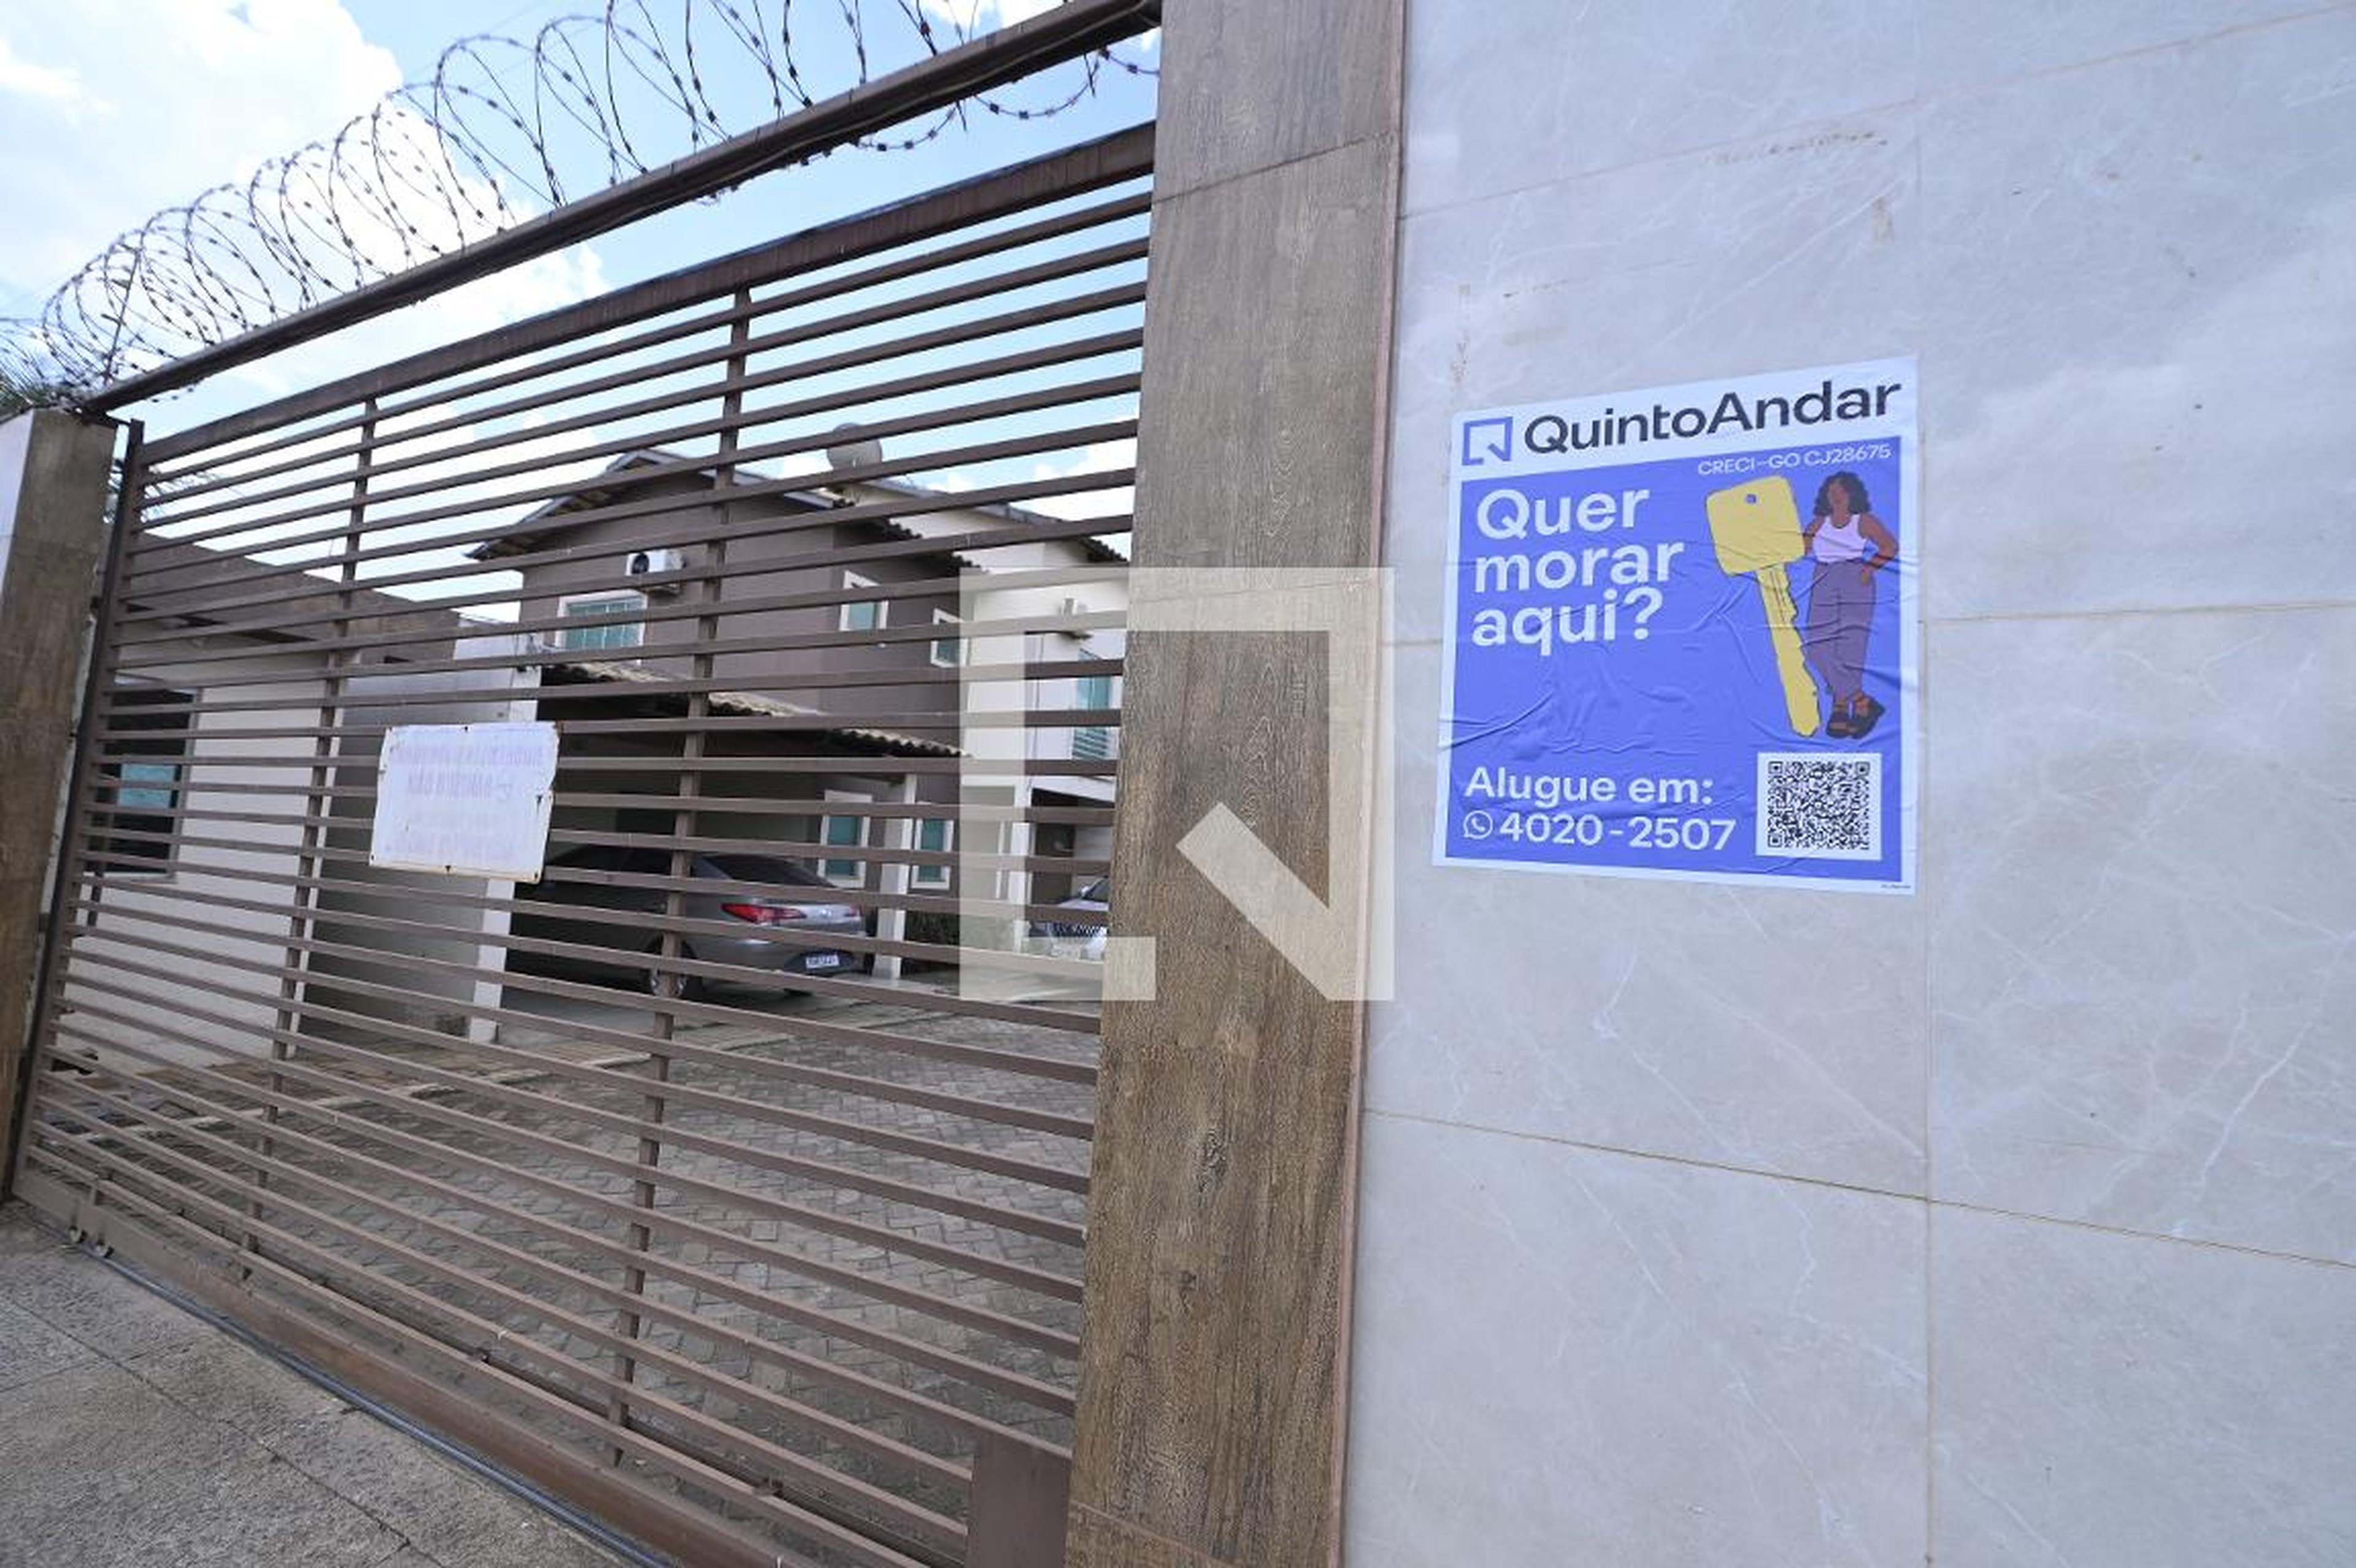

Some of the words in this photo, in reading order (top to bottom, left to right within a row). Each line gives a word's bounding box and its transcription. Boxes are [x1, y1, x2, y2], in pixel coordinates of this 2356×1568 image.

[1524, 380, 1901, 453] QuintoAndar
[1803, 444, 1892, 467] CJ28675
[1477, 488, 1650, 540] Quer
[1474, 540, 1685, 594] morar
[1472, 586, 1664, 656] aqui?
[1465, 766, 1617, 809] Alugue
[1628, 772, 1714, 805] em:
[1500, 813, 1736, 850] 4020-2507
